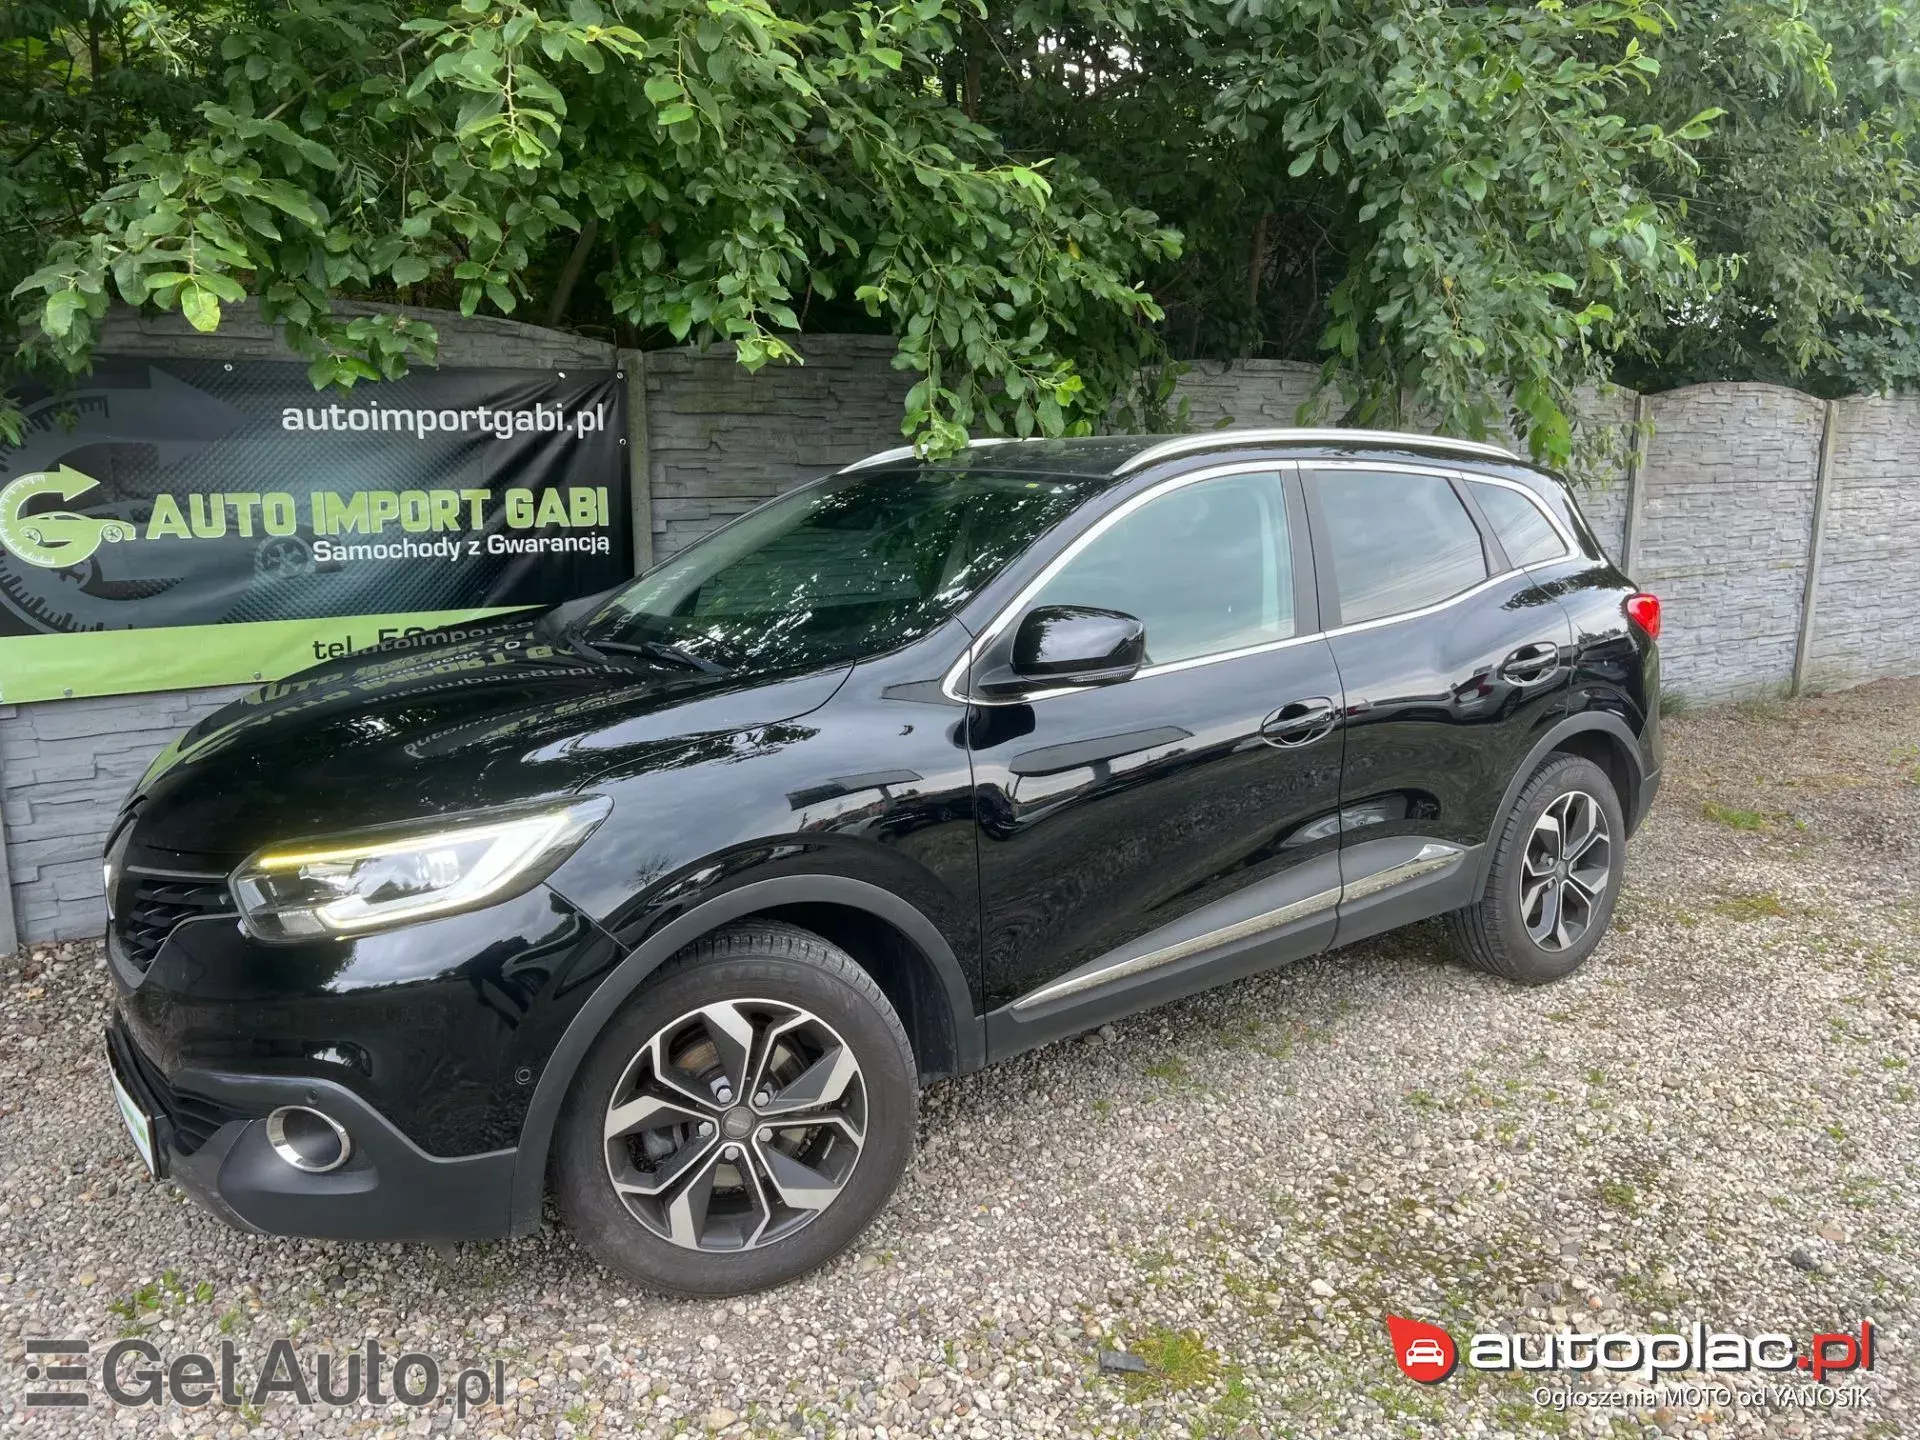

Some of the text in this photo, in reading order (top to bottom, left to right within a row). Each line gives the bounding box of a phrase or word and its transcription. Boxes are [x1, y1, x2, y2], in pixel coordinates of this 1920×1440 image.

[281, 400, 605, 440] autoimportgabi.pl
[146, 487, 610, 540] AUTO IMPORT GABI
[313, 531, 611, 562] Samochody z Gwarancją
